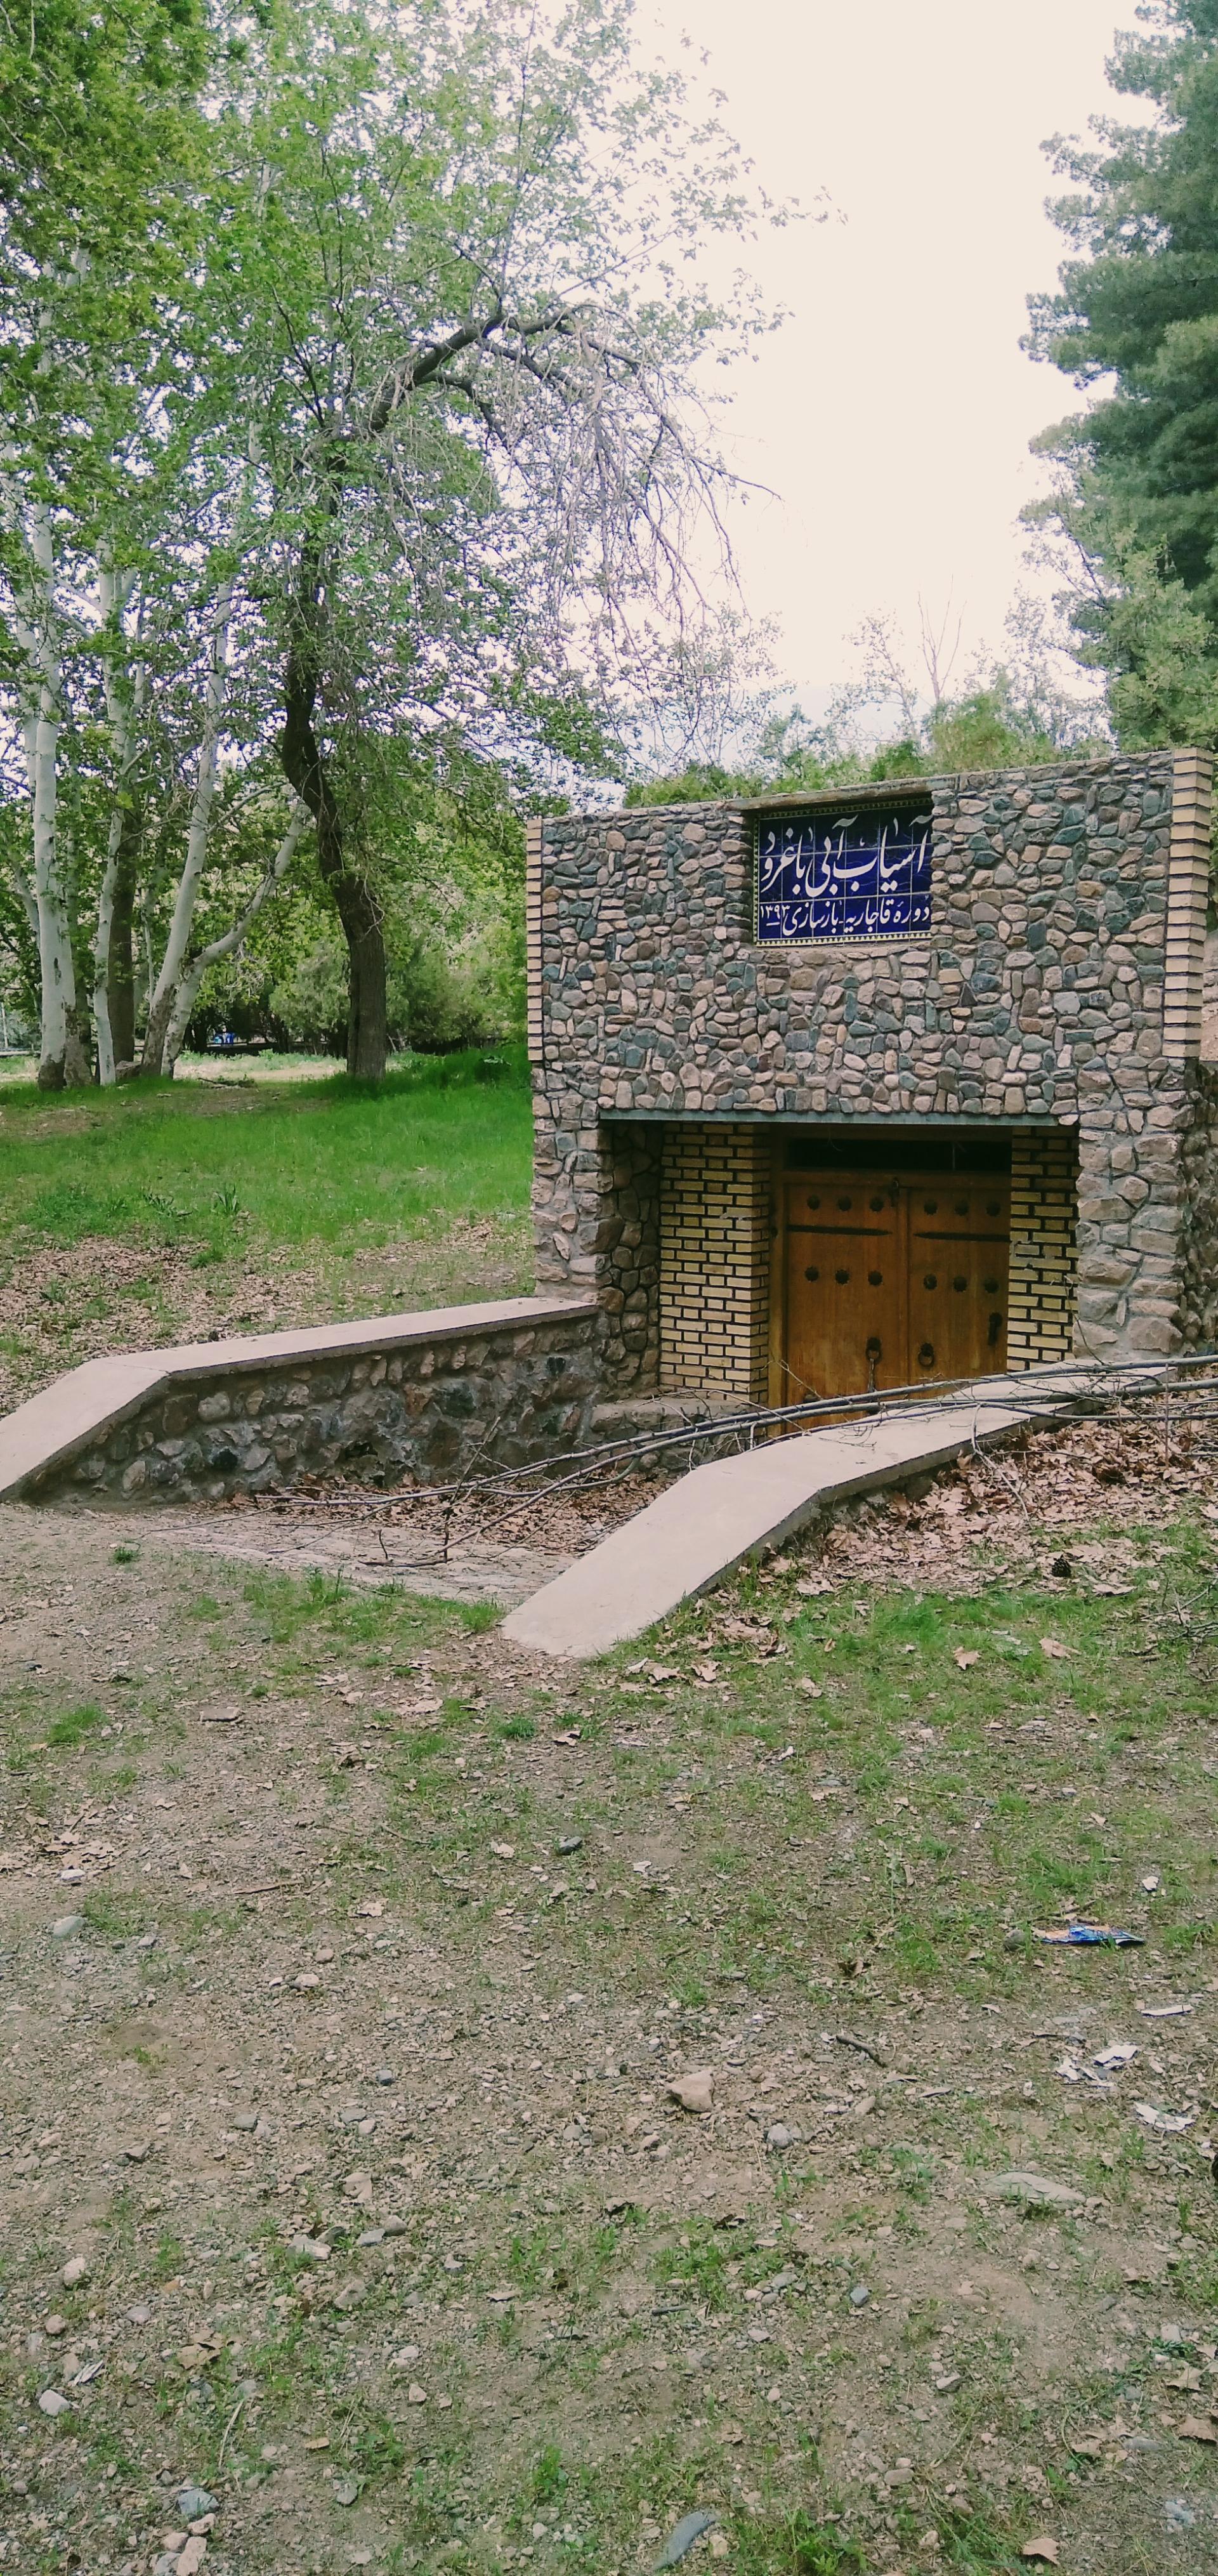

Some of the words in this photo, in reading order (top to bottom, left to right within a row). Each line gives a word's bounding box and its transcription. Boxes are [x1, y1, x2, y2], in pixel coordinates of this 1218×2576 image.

[760, 826, 806, 895] باغرود
[805, 814, 858, 897] آبی
[833, 815, 933, 893] آسیاب
[760, 904, 790, 919] ۱۳۹۳
[782, 901, 839, 936] بازسازی
[844, 897, 894, 933] قاجاریه
